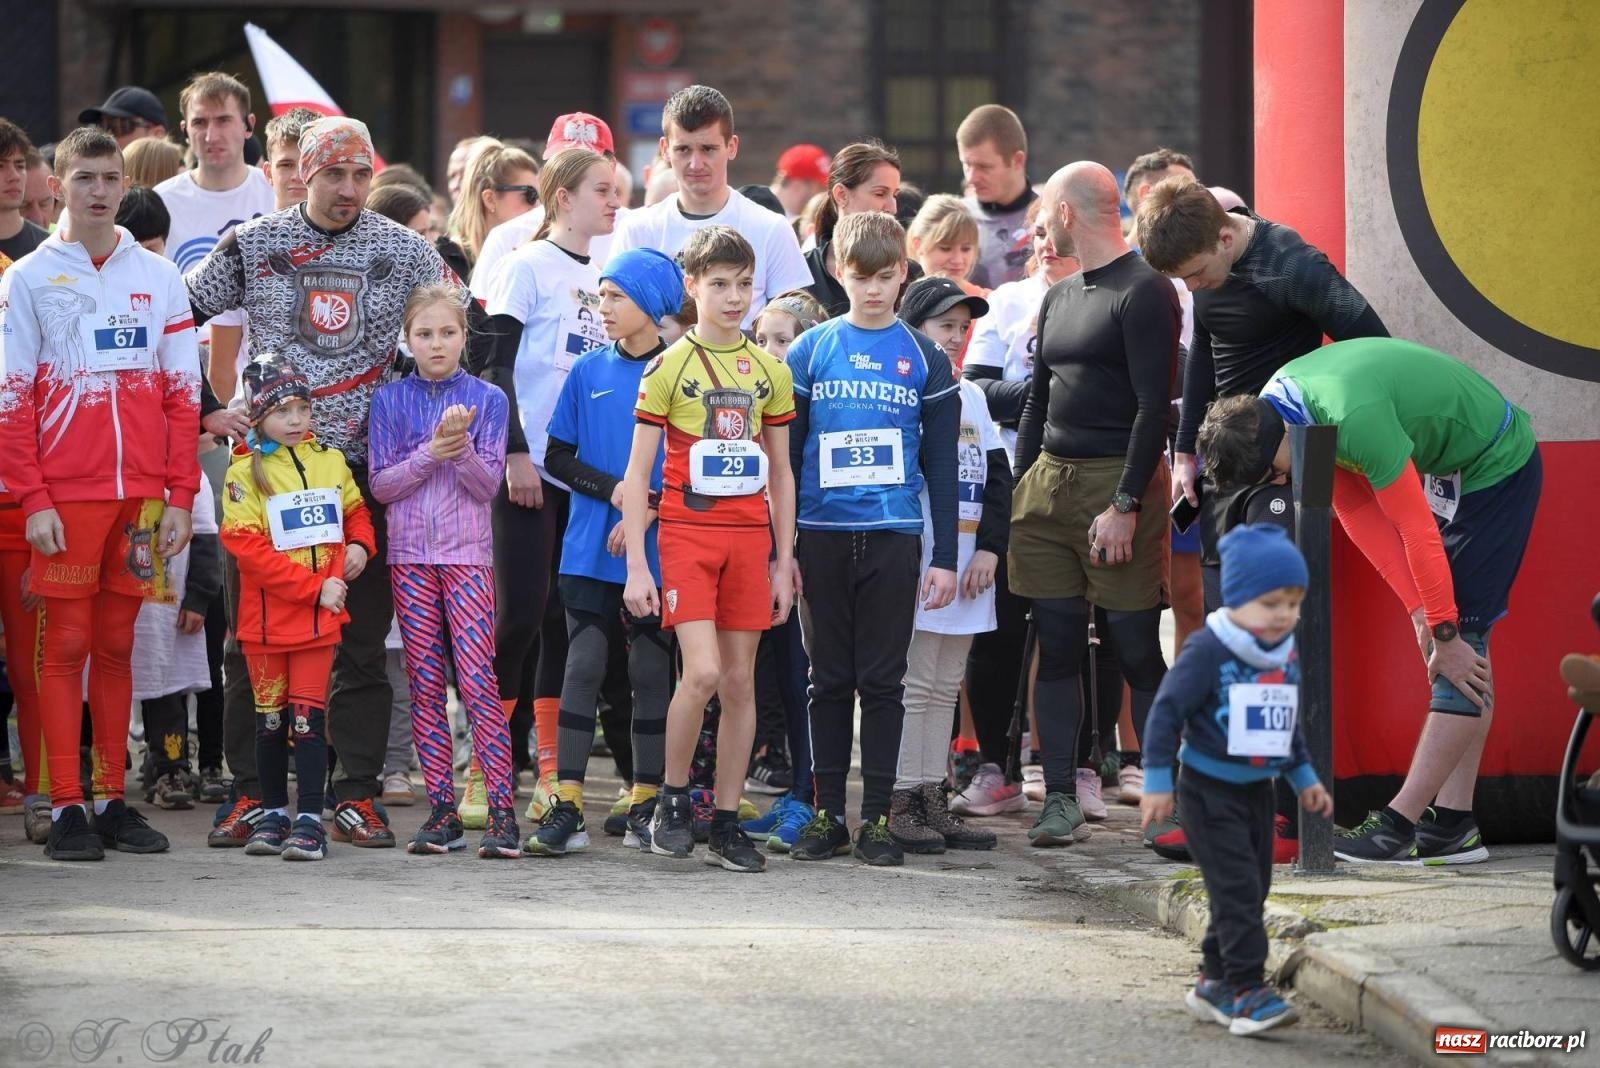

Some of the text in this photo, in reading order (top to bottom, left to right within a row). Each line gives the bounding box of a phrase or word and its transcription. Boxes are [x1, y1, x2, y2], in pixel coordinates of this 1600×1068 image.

[114, 328, 137, 347] 67
[318, 335, 339, 347] OCR
[811, 380, 918, 407] RUNNERS
[877, 403, 900, 415] TEAM
[849, 447, 875, 465] 33
[721, 457, 744, 475] 29
[300, 506, 326, 526] 68
[1260, 706, 1292, 729] 101
